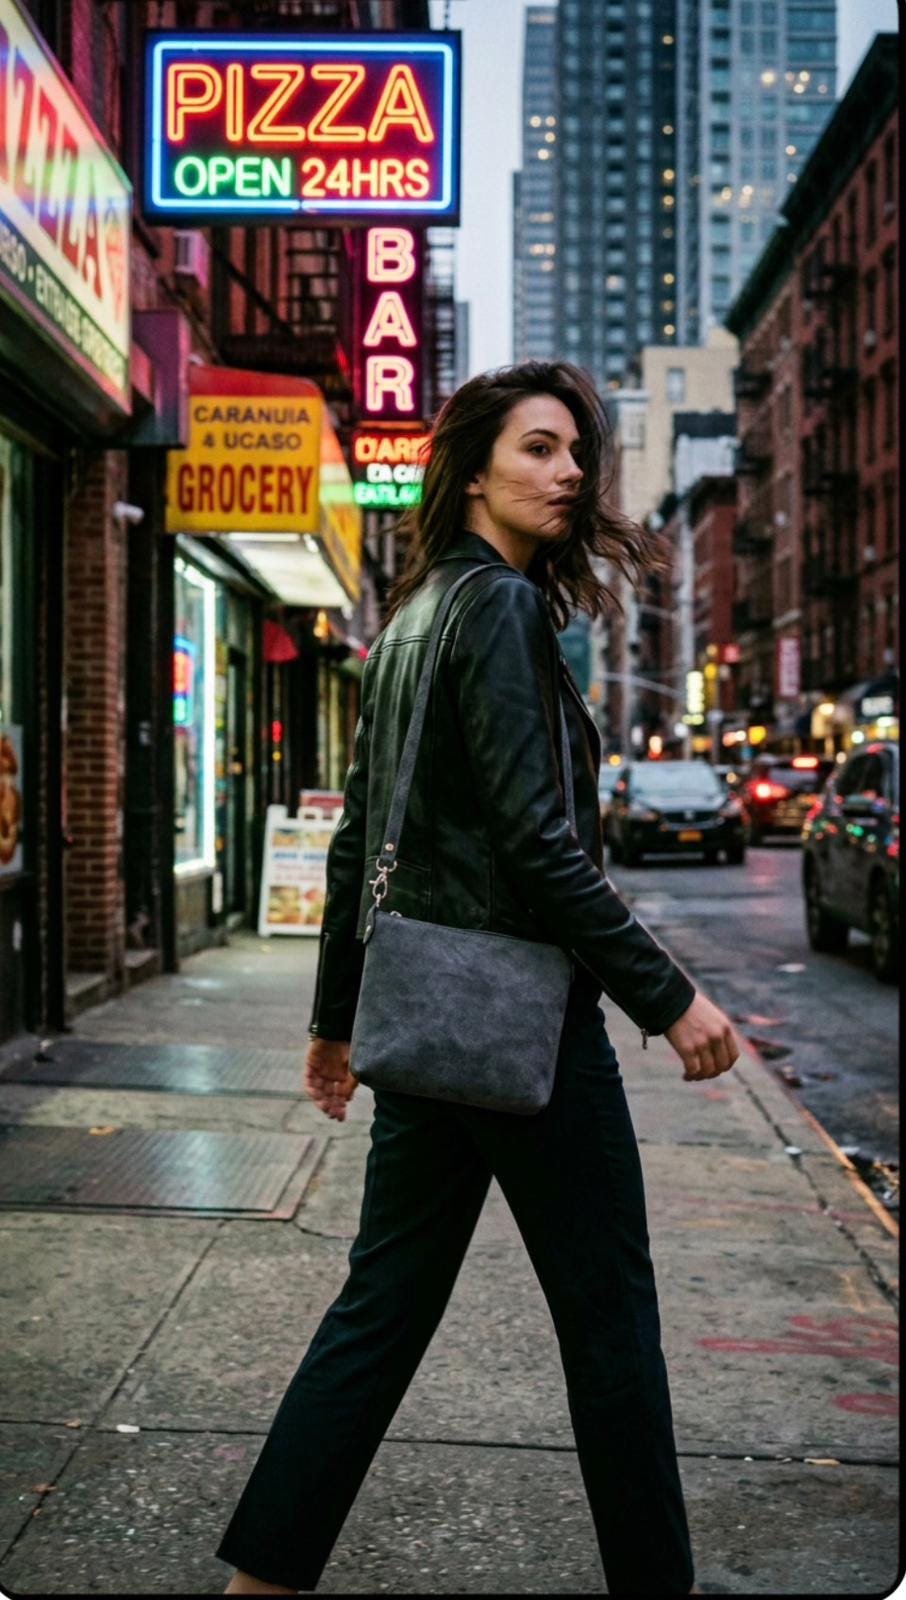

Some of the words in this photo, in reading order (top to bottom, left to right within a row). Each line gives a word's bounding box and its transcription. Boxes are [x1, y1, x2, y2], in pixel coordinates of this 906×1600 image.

[166, 62, 435, 143] PIZZA
[173, 156, 292, 197] OPEN
[301, 157, 430, 198] 24HRS
[363, 226, 418, 412] BAR
[224, 432, 303, 450] UCASO
[177, 462, 314, 515] GROCERY
